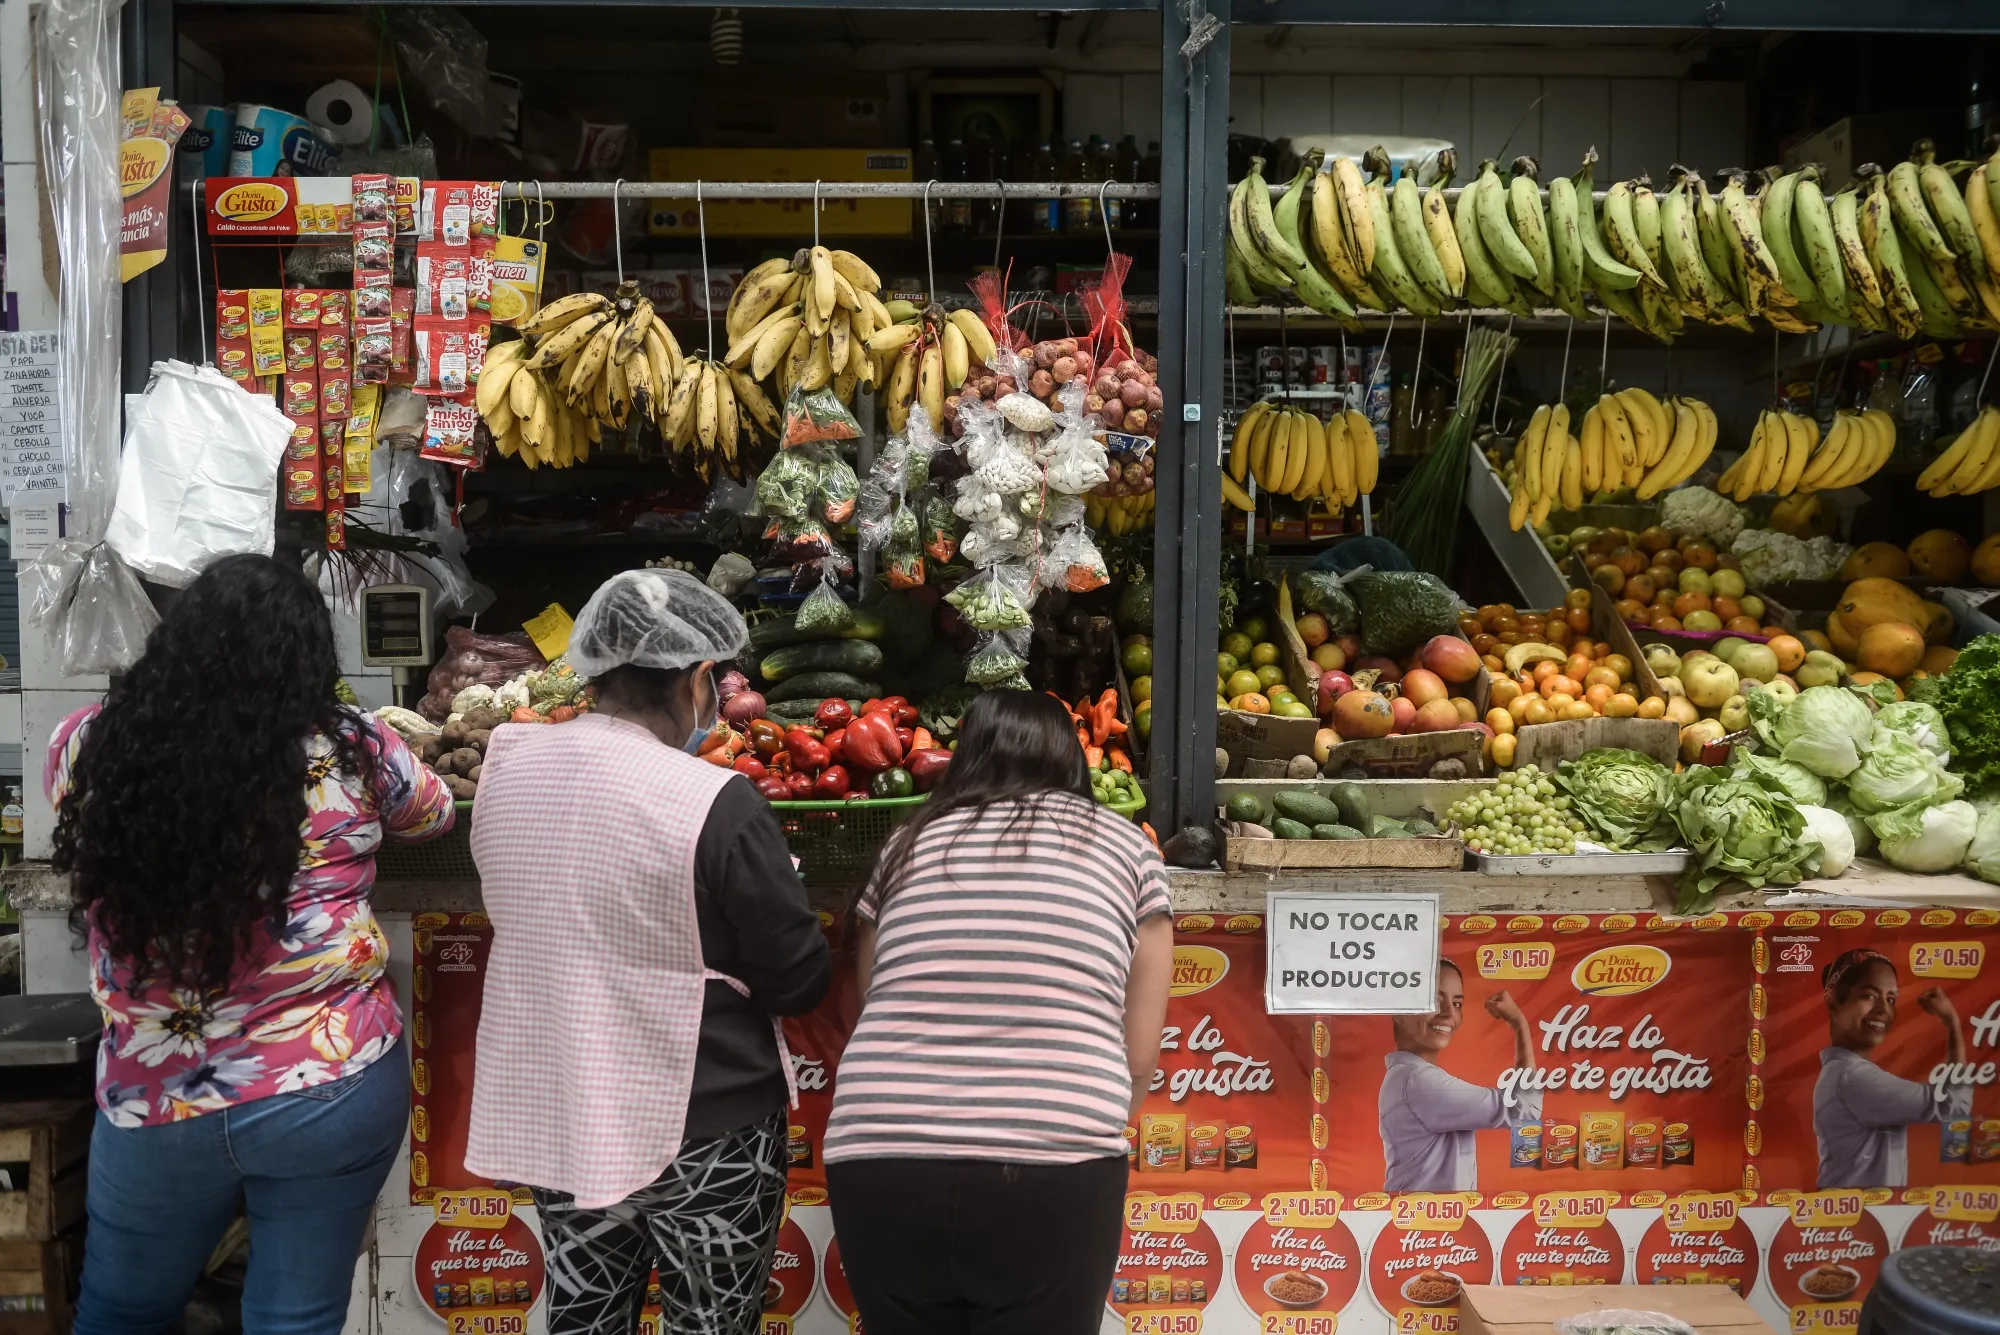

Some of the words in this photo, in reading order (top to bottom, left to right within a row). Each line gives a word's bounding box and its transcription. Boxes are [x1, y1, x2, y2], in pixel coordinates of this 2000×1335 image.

[233, 127, 259, 146] Elite
[293, 136, 338, 172] Elite
[225, 193, 277, 212] Gusta
[128, 205, 153, 226] más
[121, 225, 149, 243] ancia
[495, 266, 527, 280] men
[647, 287, 680, 298] Nova
[701, 285, 733, 297] Nova
[0, 337, 28, 356] STA
[31, 336, 47, 353] DE
[10, 356, 34, 366] PAPA
[4, 368, 50, 379] ZANAHORIA
[10, 383, 45, 393] TOMATE
[12, 396, 51, 406] ALVERJA
[19, 411, 45, 421] YUCA
[434, 408, 472, 420] miski
[10, 424, 45, 434] CAMOTE
[14, 437, 50, 447] CEBOLLA
[19, 452, 51, 462] CHOCLO
[13, 465, 43, 476] CEBOLLA
[24, 478, 59, 490] VAINITA
[1290, 912, 1330, 930] NO
[1337, 913, 1419, 931] TOCAR
[1741, 917, 1768, 926] Gusta
[1787, 916, 1814, 925] Gusta
[1330, 941, 1376, 960] LOS
[1174, 956, 1193, 967] oña
[1608, 955, 1635, 965] Doña
[1171, 963, 1213, 983] usta
[1282, 970, 1421, 988] PRODUCTOS
[1584, 959, 1656, 983] Gusta
[1187, 1014, 1225, 1051] lo
[1539, 1004, 1623, 1052] Haz
[1628, 1014, 1665, 1049] lo
[1169, 1052, 1274, 1102] gusta
[1497, 1066, 1566, 1108] que
[1570, 1059, 1605, 1089] te
[1608, 1049, 1712, 1100] gusta
[1929, 1061, 1996, 1102] que
[1152, 1124, 1174, 1133] Gusta
[1591, 1122, 1613, 1131] Gusta
[1217, 1195, 1244, 1206] Gusta
[1357, 1195, 1384, 1206] Gusta
[1496, 1195, 1523, 1206] Gusta
[1634, 1194, 1660, 1204] Gusta
[447, 1230, 487, 1253] Haz
[489, 1233, 506, 1250] lo
[1129, 1231, 1167, 1249] Haz
[1170, 1233, 1187, 1248] lo
[1270, 1228, 1307, 1249] Haz
[1310, 1235, 1327, 1250] lo
[1400, 1231, 1437, 1252] Haz
[1440, 1232, 1456, 1247] lo
[1534, 1228, 1570, 1246] Haz
[1573, 1231, 1589, 1246] lo
[1669, 1232, 1707, 1247] Haz
[1708, 1231, 1724, 1247] lo
[1800, 1227, 1836, 1245] Haz
[1838, 1226, 1853, 1242] lo
[1929, 1222, 1964, 1243] Haz
[431, 1259, 462, 1279] que
[464, 1254, 481, 1270] te
[482, 1248, 530, 1273] gusta
[1114, 1256, 1143, 1273] que
[1145, 1252, 1161, 1266] te
[1162, 1248, 1208, 1271] gusta
[1251, 1252, 1282, 1271] que
[1284, 1253, 1299, 1267] te
[1300, 1250, 1347, 1272] gusta
[1384, 1259, 1415, 1278] que
[1416, 1254, 1432, 1268] te
[1433, 1245, 1478, 1270] gusta
[1516, 1252, 1547, 1270] que
[1548, 1249, 1564, 1264] te
[1565, 1246, 1611, 1268] gusta
[1651, 1254, 1681, 1271] que
[1683, 1250, 1699, 1264] te
[1700, 1246, 1745, 1268] gusta
[1783, 1252, 1813, 1270] que
[1814, 1247, 1830, 1261] te
[1831, 1240, 1875, 1263] gusta
